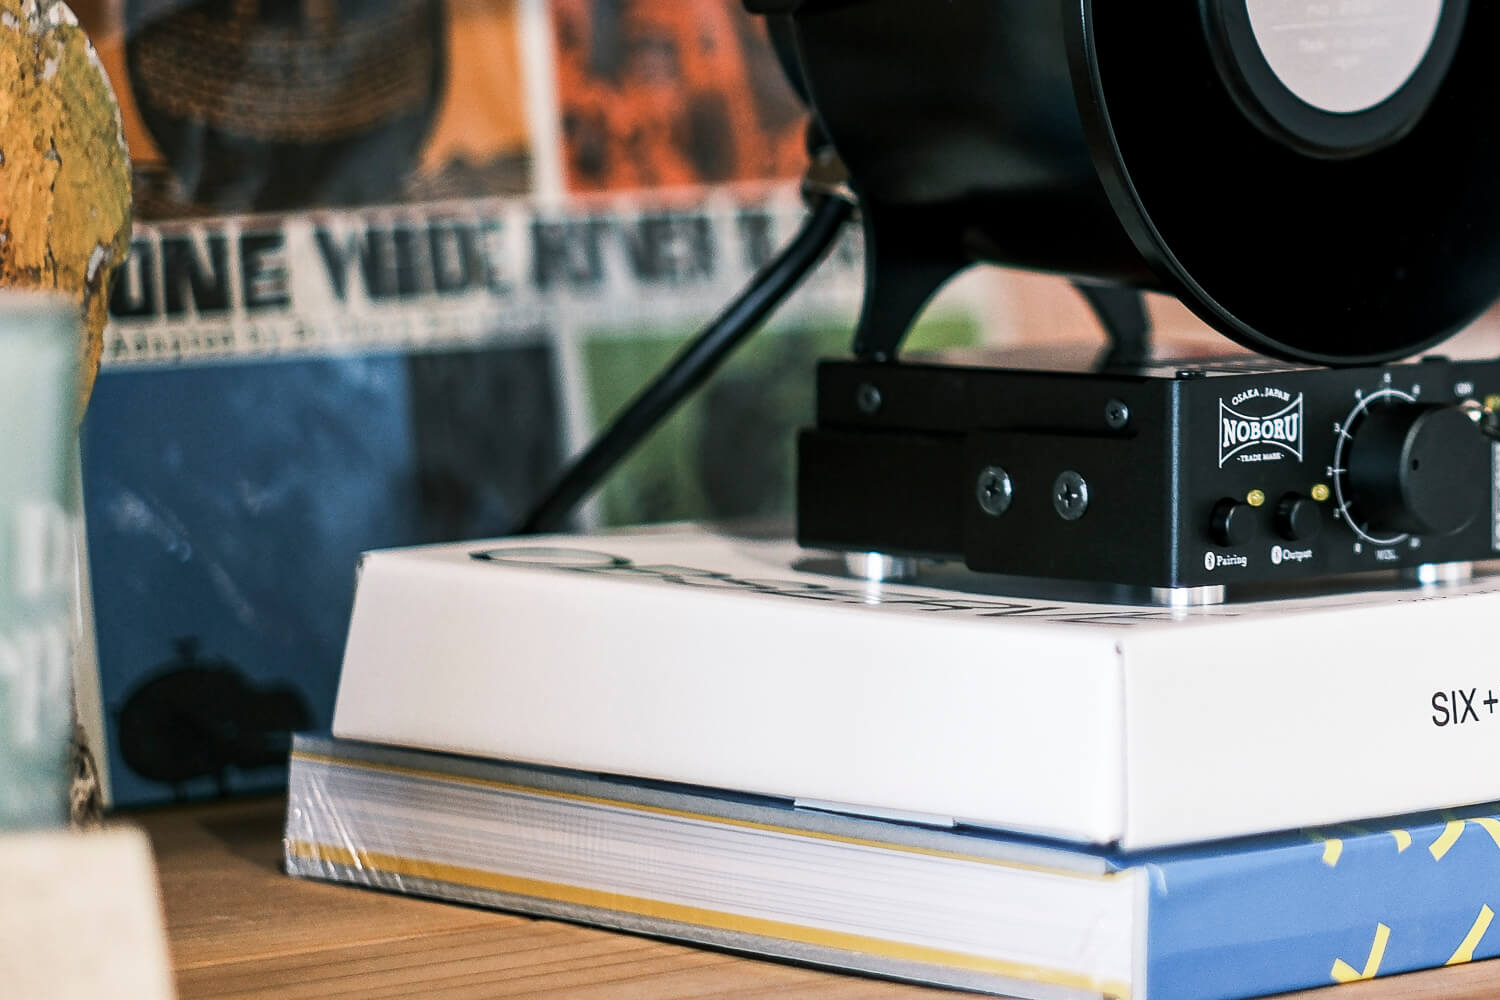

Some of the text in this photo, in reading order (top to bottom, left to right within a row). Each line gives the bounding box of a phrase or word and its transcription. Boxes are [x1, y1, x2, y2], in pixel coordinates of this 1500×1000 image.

[109, 231, 296, 319] ONE
[1222, 412, 1299, 448] NOBORU
[1216, 554, 1248, 568] Pairing
